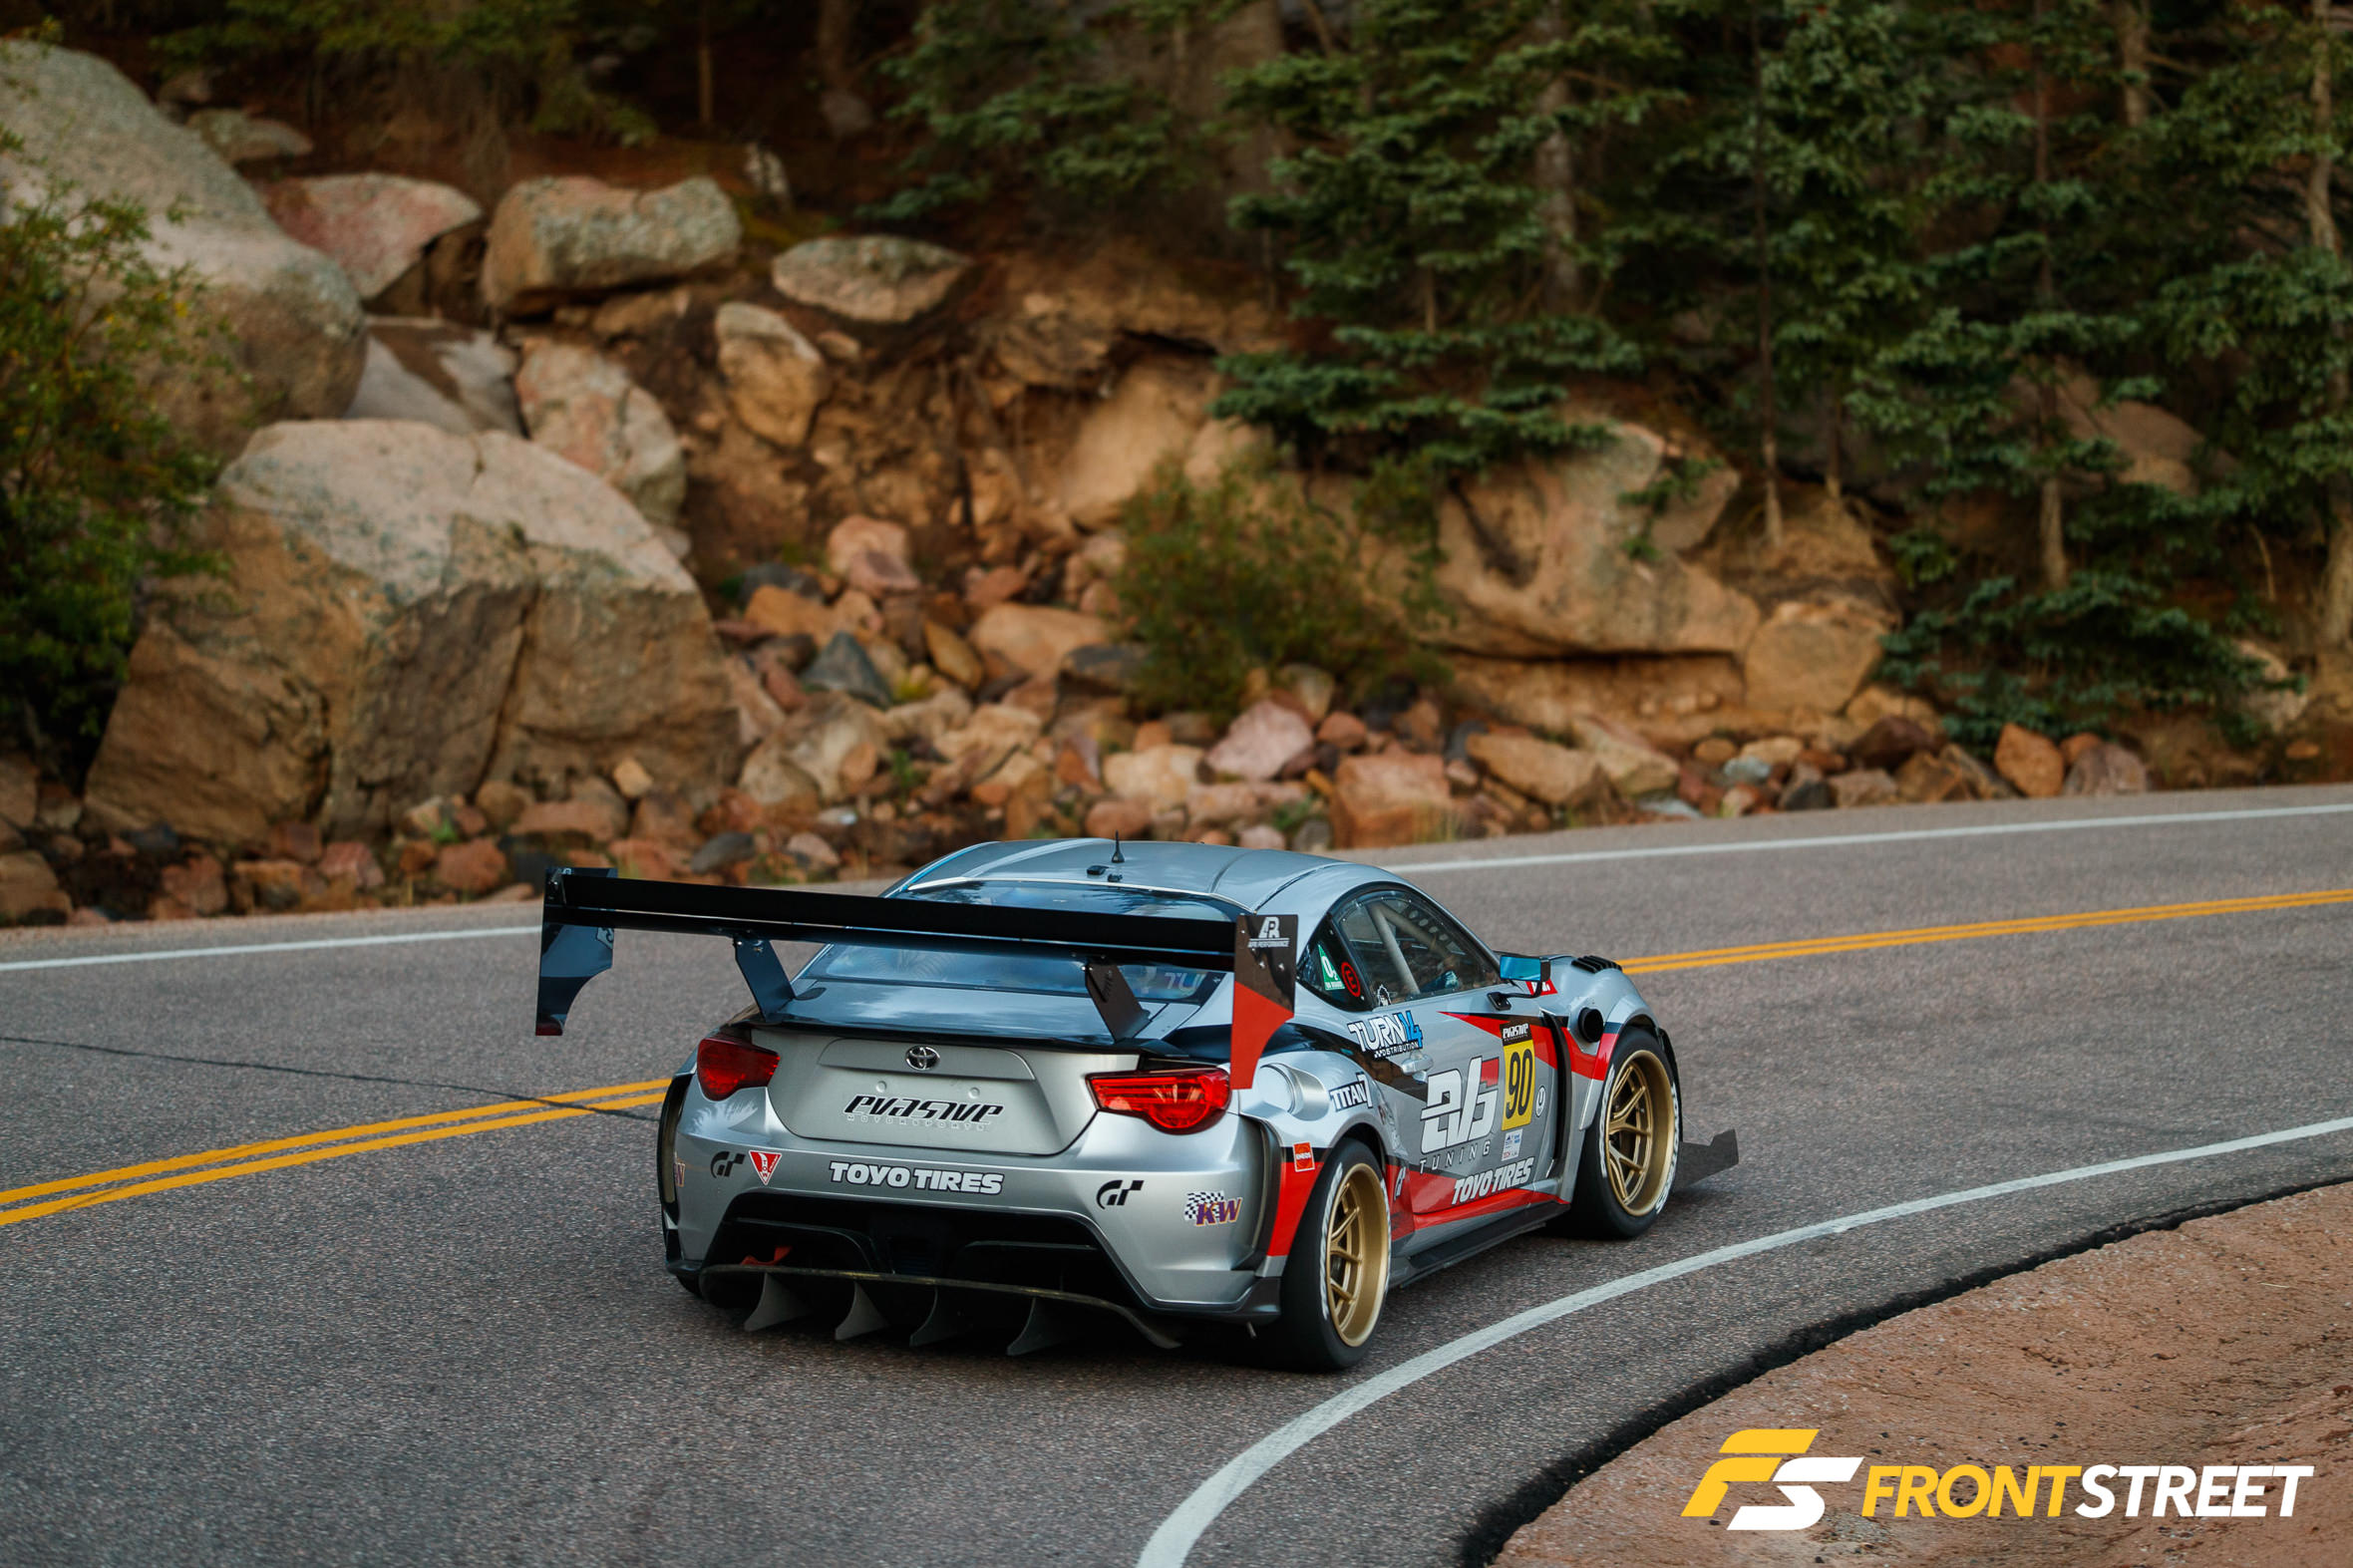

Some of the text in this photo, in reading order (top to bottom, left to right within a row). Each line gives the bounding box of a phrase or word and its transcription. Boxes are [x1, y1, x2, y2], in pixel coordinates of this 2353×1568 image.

[1347, 1014, 1406, 1053] TURN
[1506, 1049, 1533, 1119] 90
[1419, 1139, 1492, 1175] TUNING
[831, 1161, 1004, 1194] TOYO TIRES
[1452, 1156, 1534, 1205] TOYO TIRES
[1195, 1197, 1243, 1227] KW
